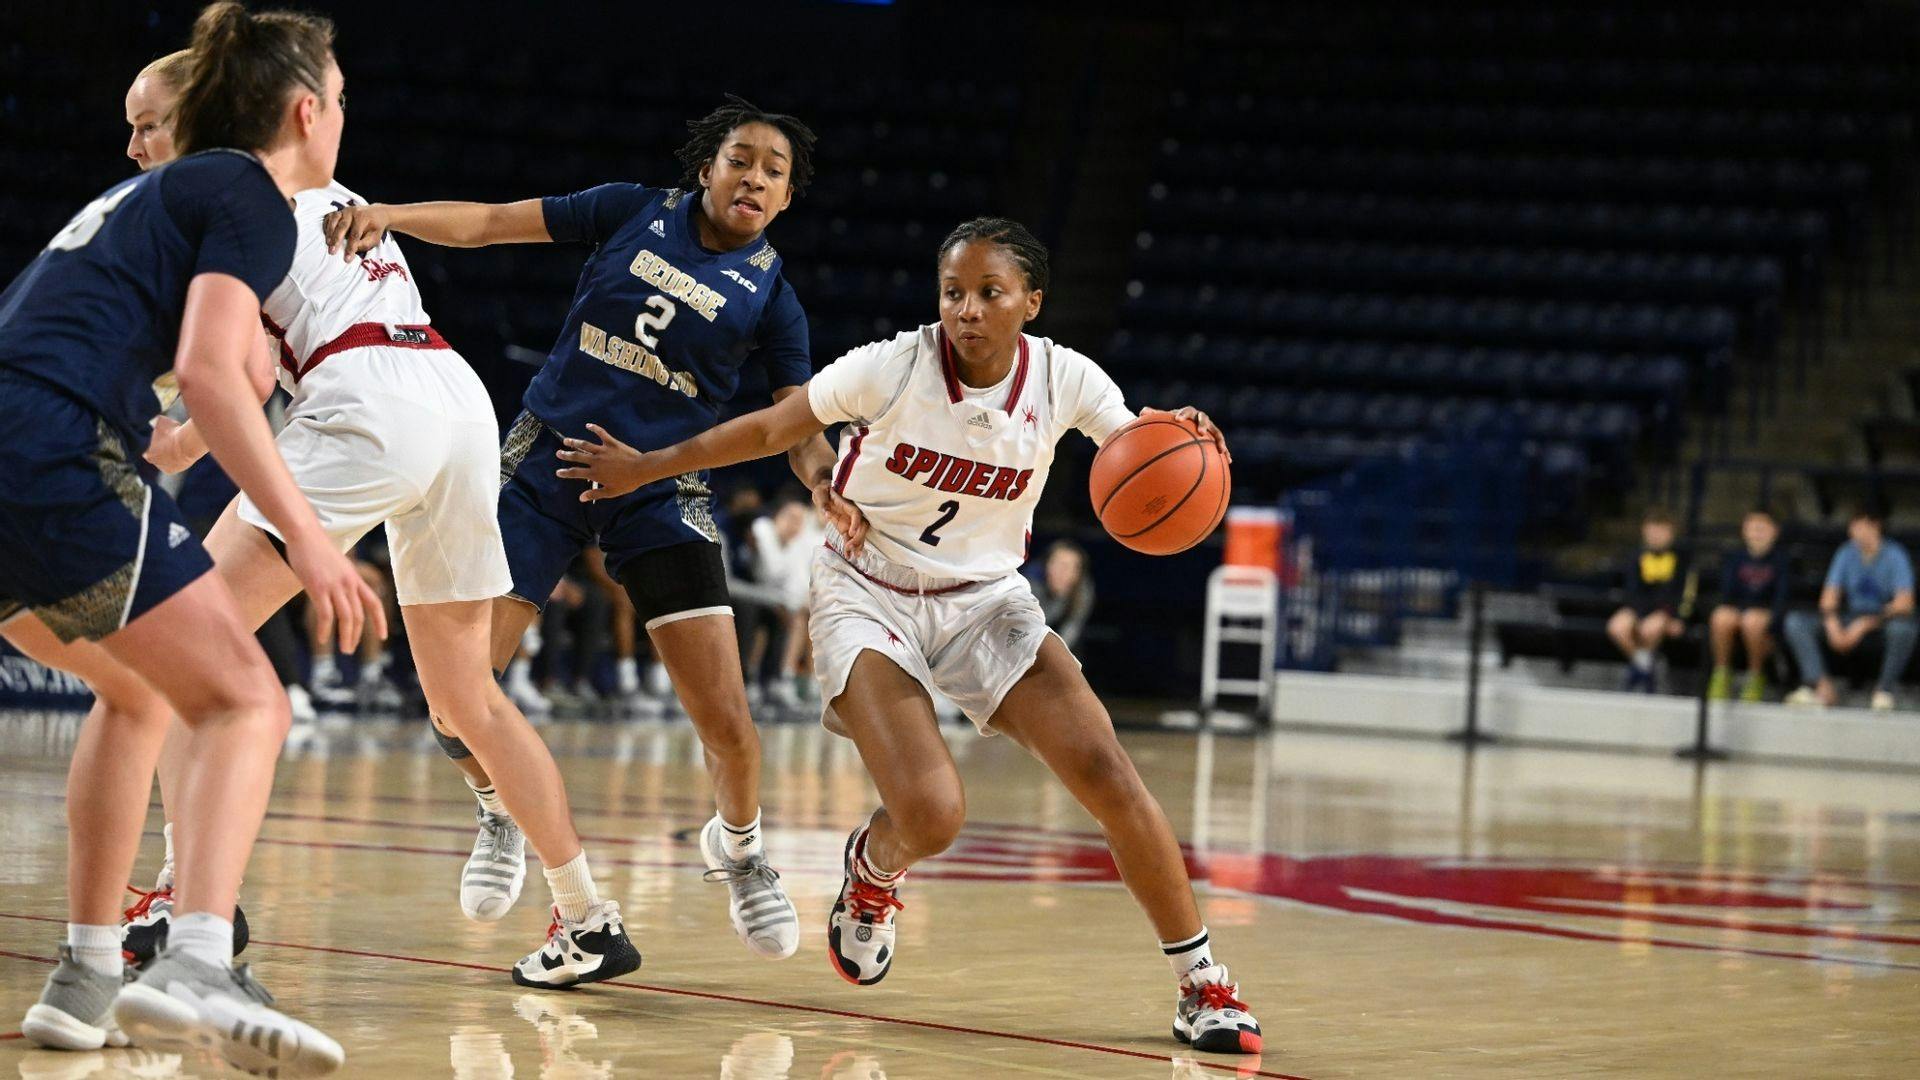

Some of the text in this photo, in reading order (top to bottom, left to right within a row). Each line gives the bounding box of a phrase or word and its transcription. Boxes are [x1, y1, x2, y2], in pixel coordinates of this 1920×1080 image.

[629, 249, 728, 323] GEORGE
[635, 294, 676, 350] 2
[885, 442, 1034, 501] SPIDERS
[918, 500, 960, 547] 2
